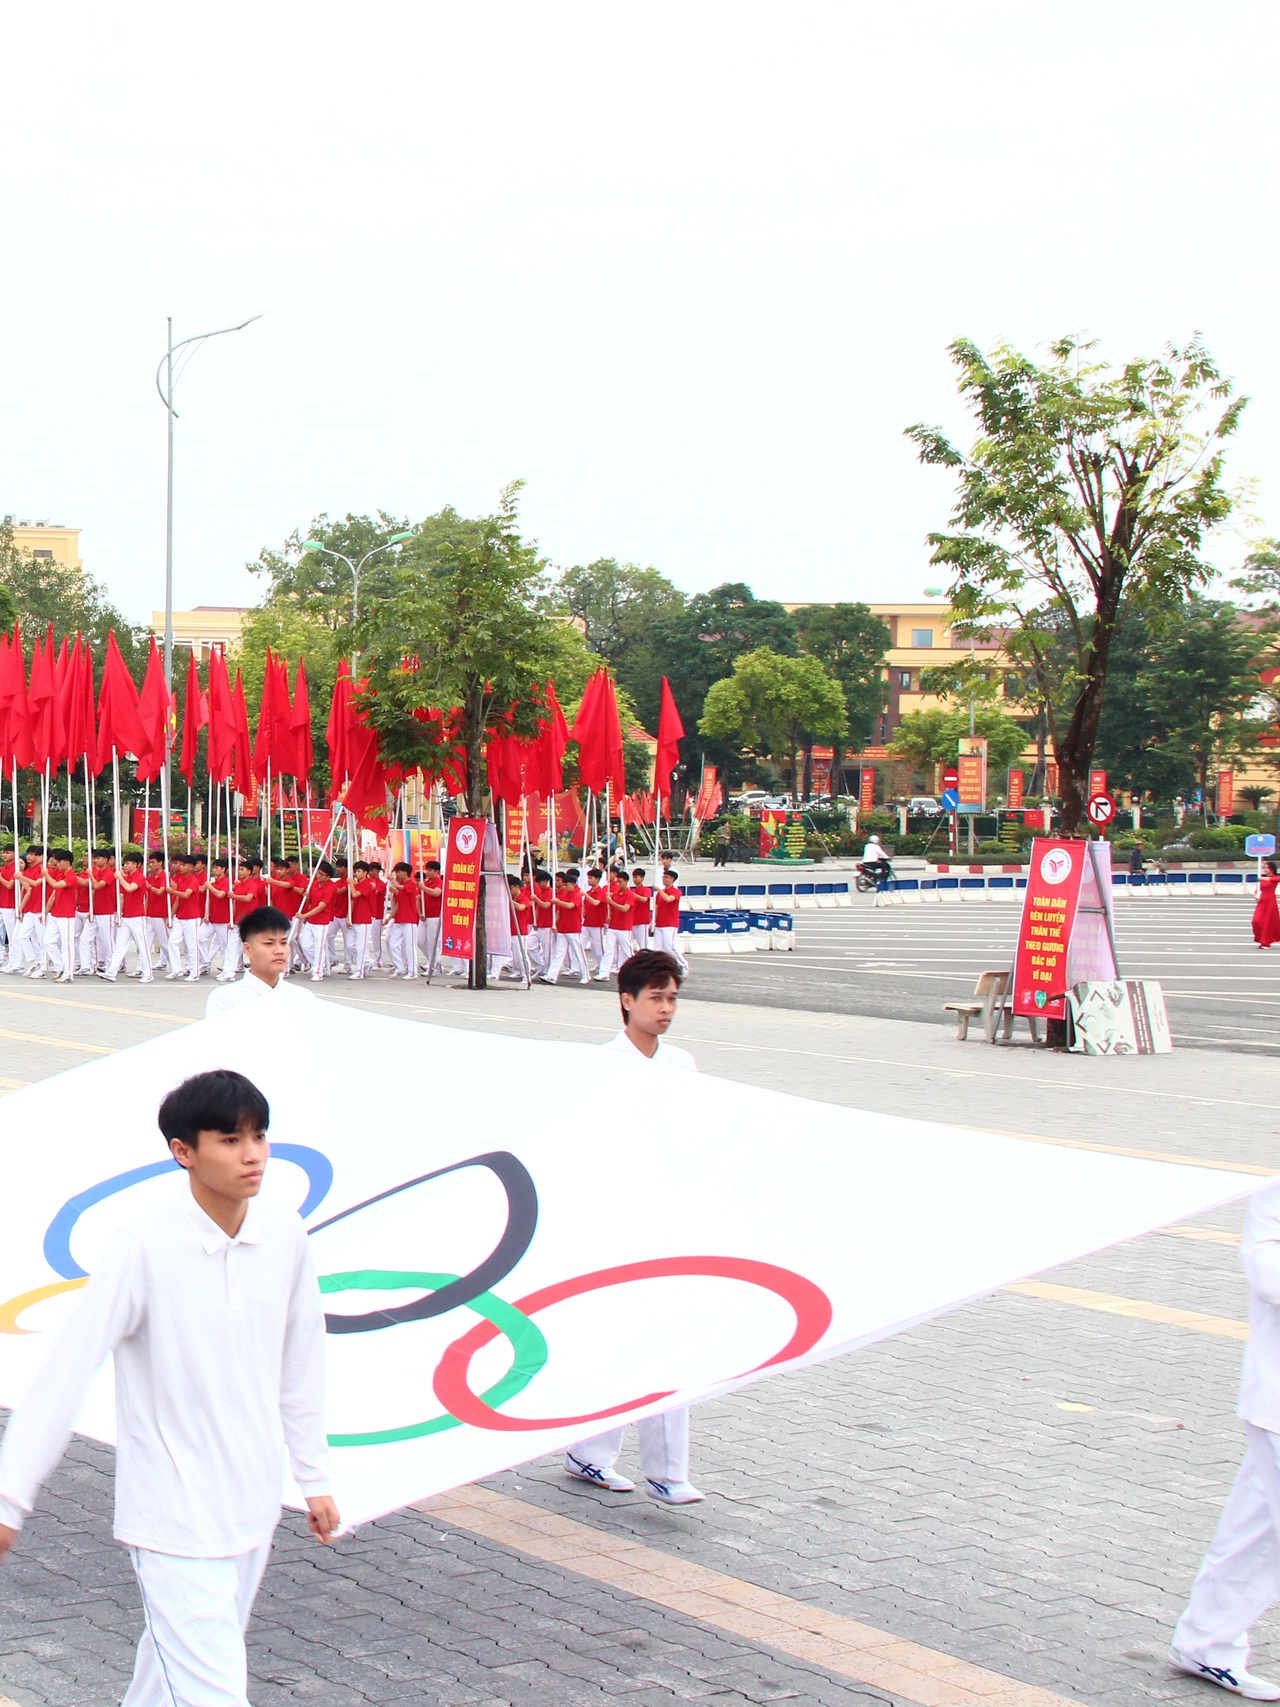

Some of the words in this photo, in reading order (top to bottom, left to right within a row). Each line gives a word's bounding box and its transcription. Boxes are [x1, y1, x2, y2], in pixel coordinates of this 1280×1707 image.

[452, 862, 467, 874] ĐOÀN
[448, 880, 466, 891] TRUNG
[447, 897, 458, 908] CAO
[1033, 896, 1051, 907] TOÀN
[1051, 897, 1067, 909] DÂN
[1030, 910, 1043, 921] RÈN
[1044, 912, 1066, 924] LUYỆN
[1030, 925, 1048, 936] THÂN
[1025, 940, 1041, 950] THEO
[1042, 942, 1065, 953] GƯƠNG
[1031, 954, 1045, 965] BÁC
[1046, 955, 1057, 967] HỒ
[1040, 971, 1052, 983] ĐẠI
